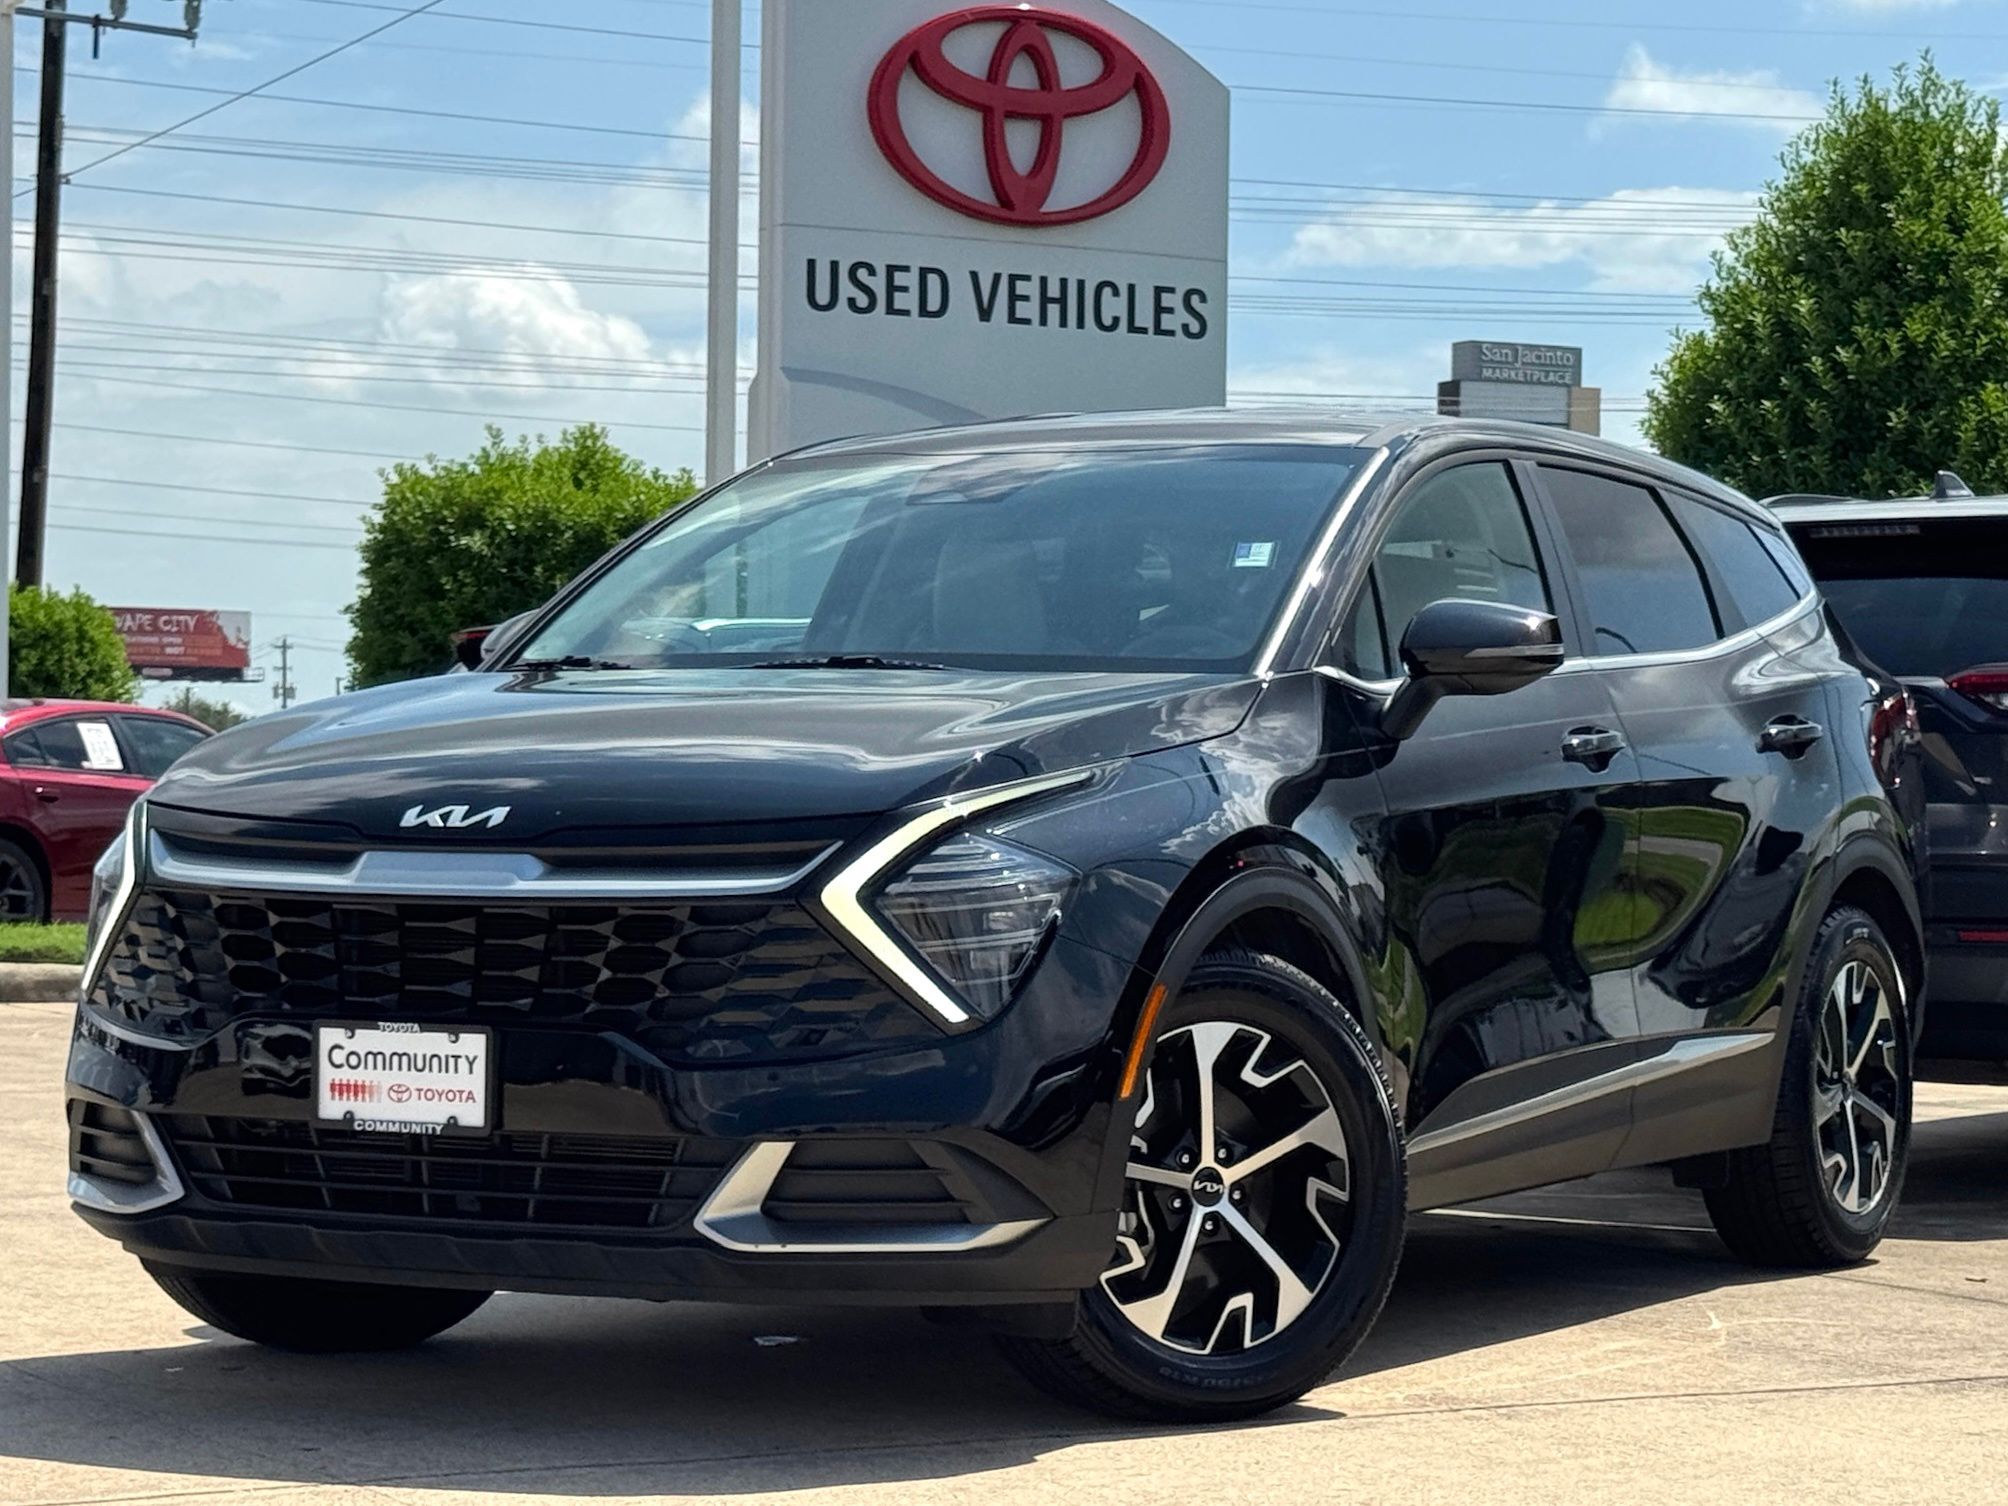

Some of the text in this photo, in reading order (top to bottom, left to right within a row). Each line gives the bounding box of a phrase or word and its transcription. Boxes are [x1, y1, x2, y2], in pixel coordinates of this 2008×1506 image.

[805, 257, 1209, 340] USED VEHICLES
[1480, 343, 1575, 367] San Jacinto
[1480, 367, 1573, 385] MARKETPLACE
[114, 612, 200, 633] VAPE CITY
[399, 804, 512, 829] KIA
[377, 1021, 421, 1033] TOYOTA
[415, 1087, 477, 1104] TOYOTA
[353, 1119, 444, 1135] COMMUNITY
